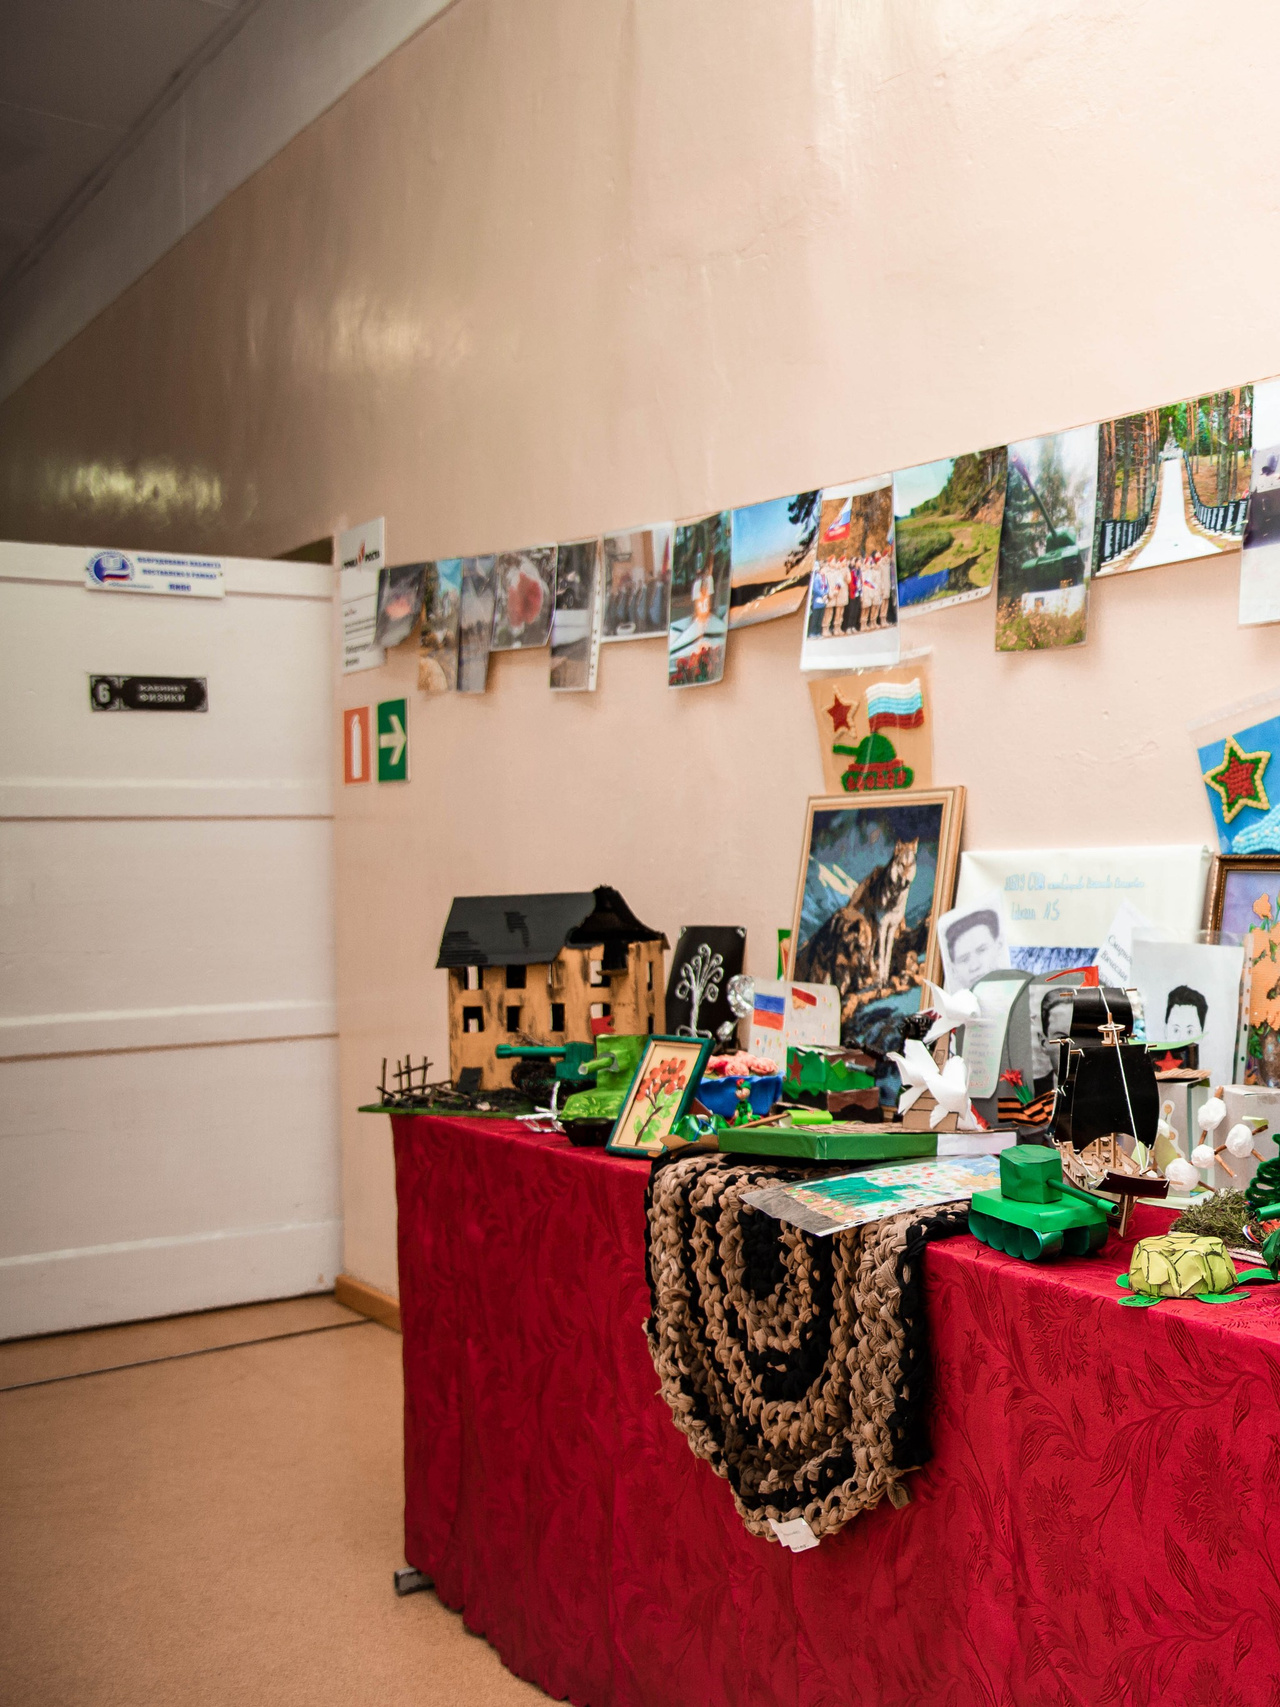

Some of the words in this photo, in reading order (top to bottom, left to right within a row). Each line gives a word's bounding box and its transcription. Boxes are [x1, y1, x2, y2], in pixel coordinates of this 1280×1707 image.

[98, 682, 111, 703] 6
[139, 684, 187, 693] КАБИНЕТ
[139, 693, 186, 702] ФИЗИКИ
